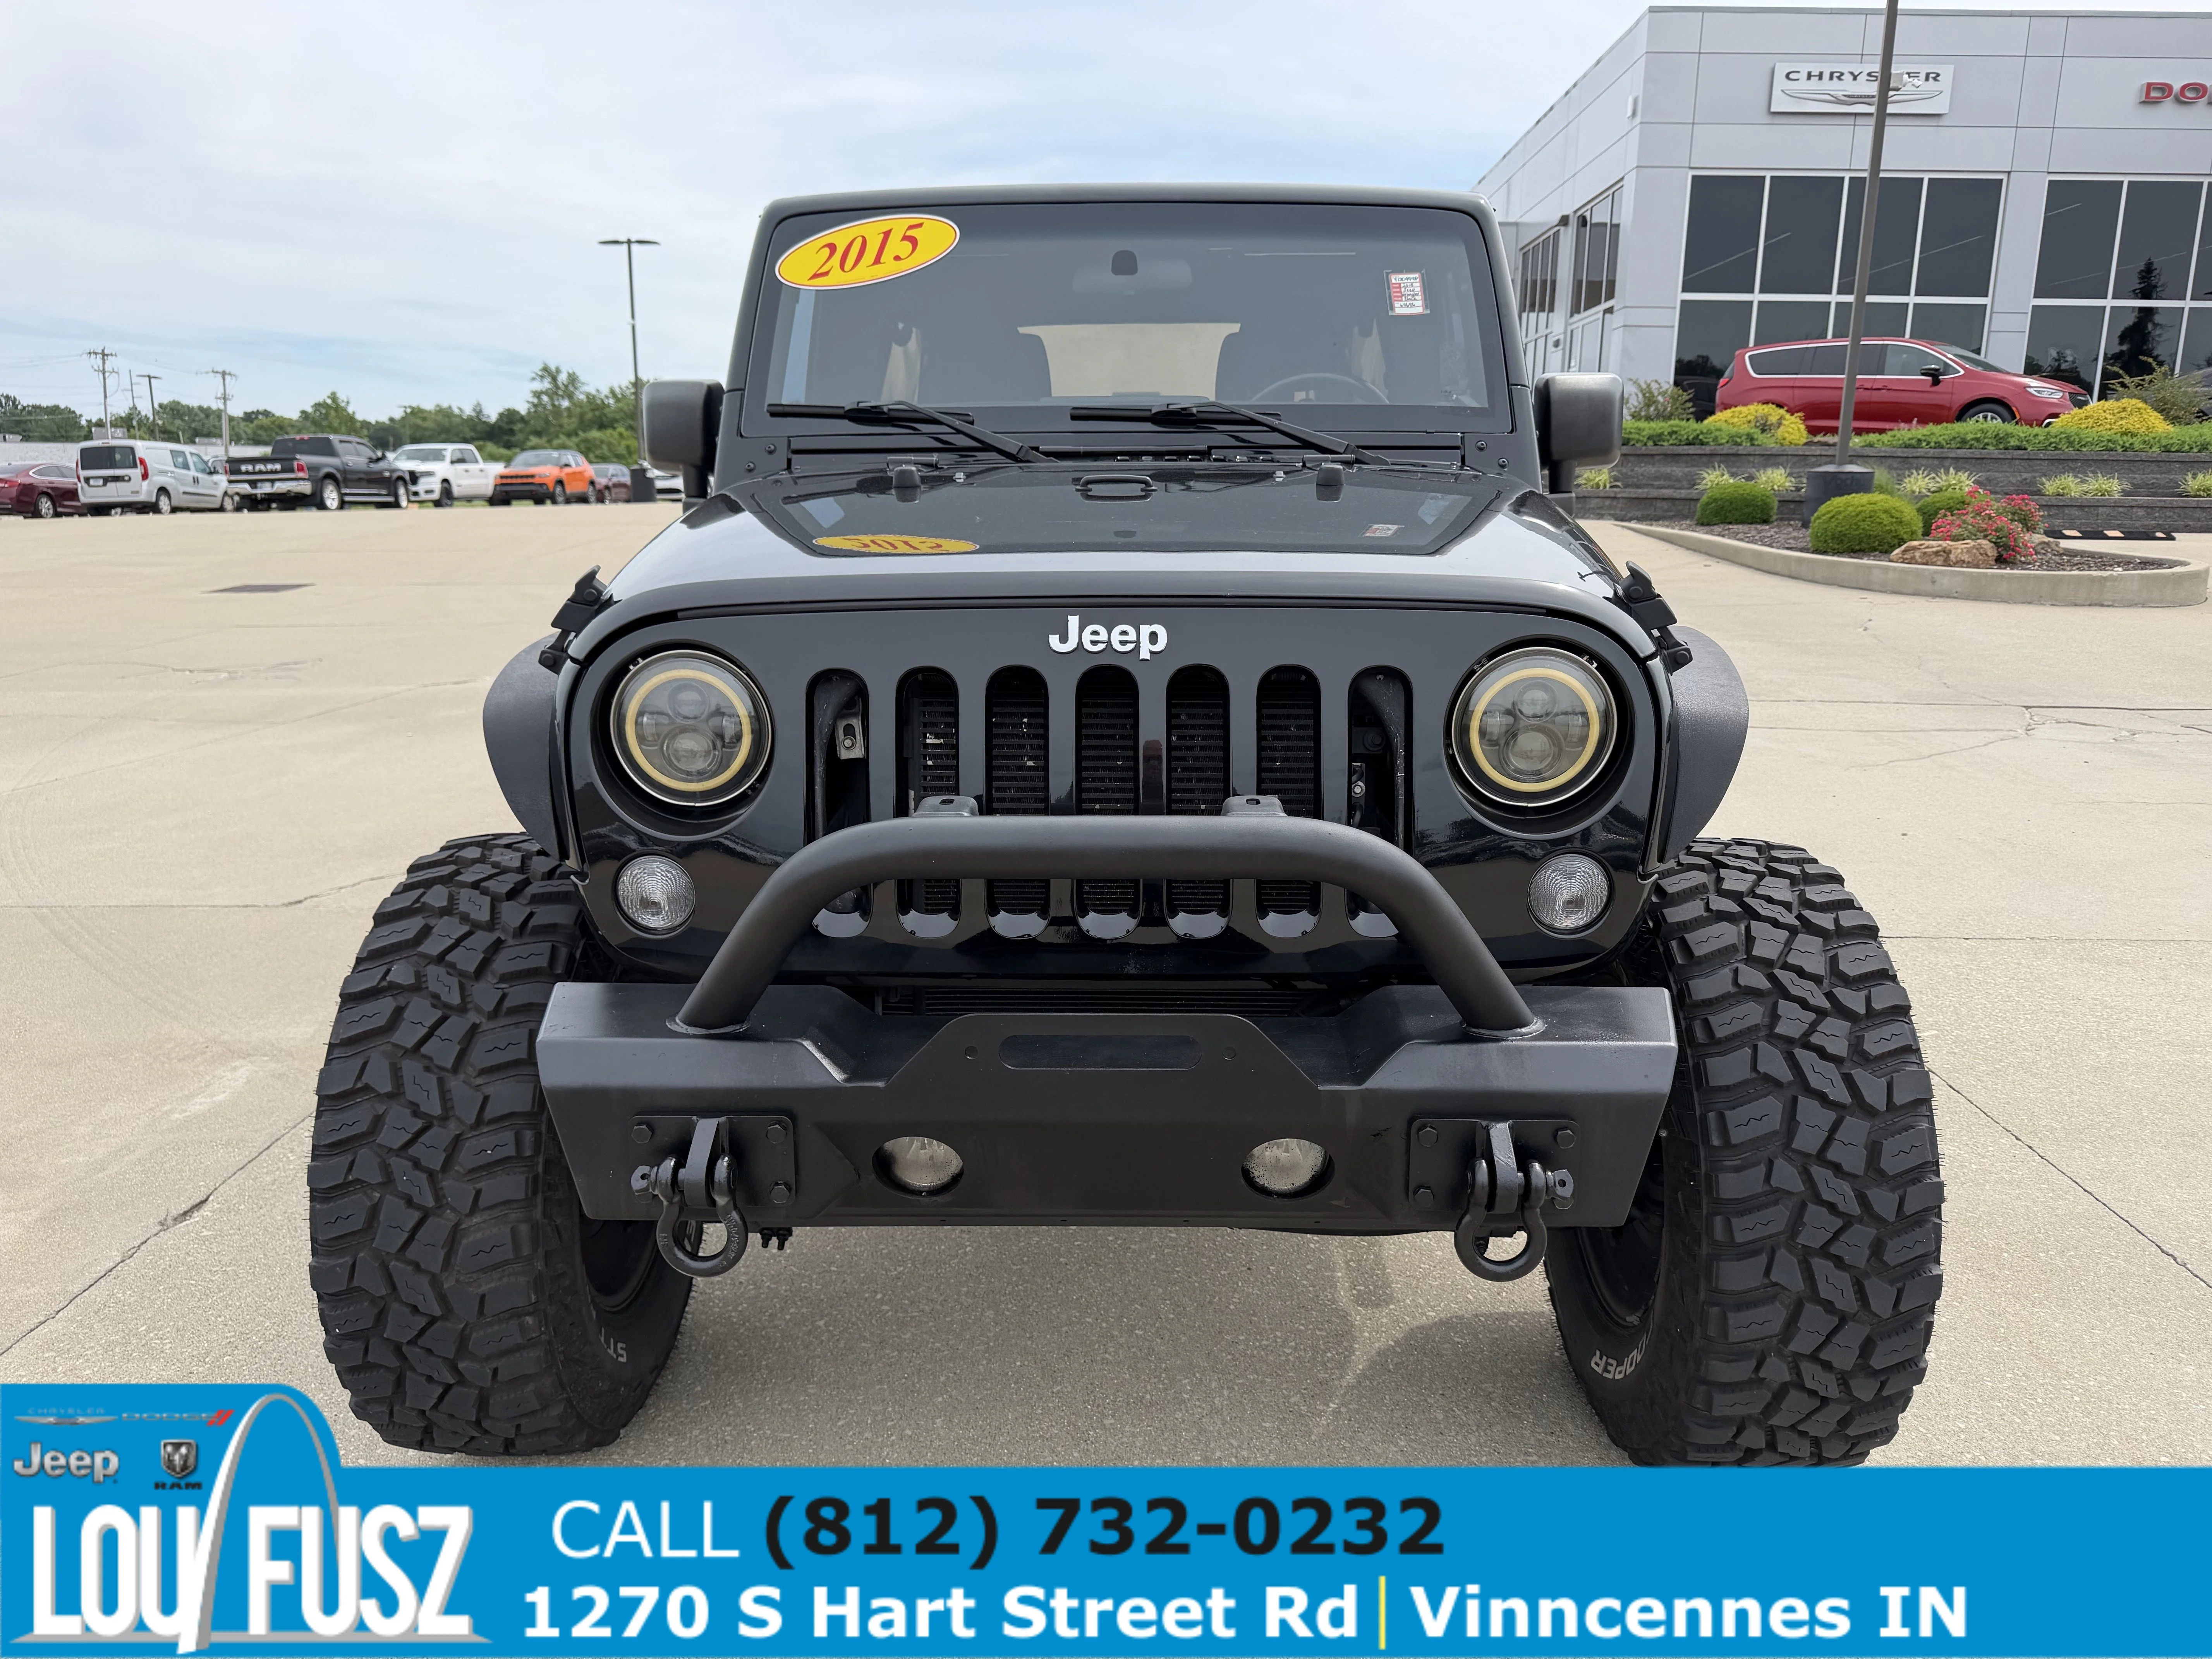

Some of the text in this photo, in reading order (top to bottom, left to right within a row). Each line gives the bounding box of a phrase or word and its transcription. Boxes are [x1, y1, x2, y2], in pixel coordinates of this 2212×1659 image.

[1784, 70, 1941, 82] CHRYSER
[2140, 81, 2212, 103] DO
[807, 222, 924, 282] 2015
[240, 463, 282, 472] RAM
[1049, 615, 1168, 661] Jeep
[1590, 1309, 1653, 1380] OOPER
